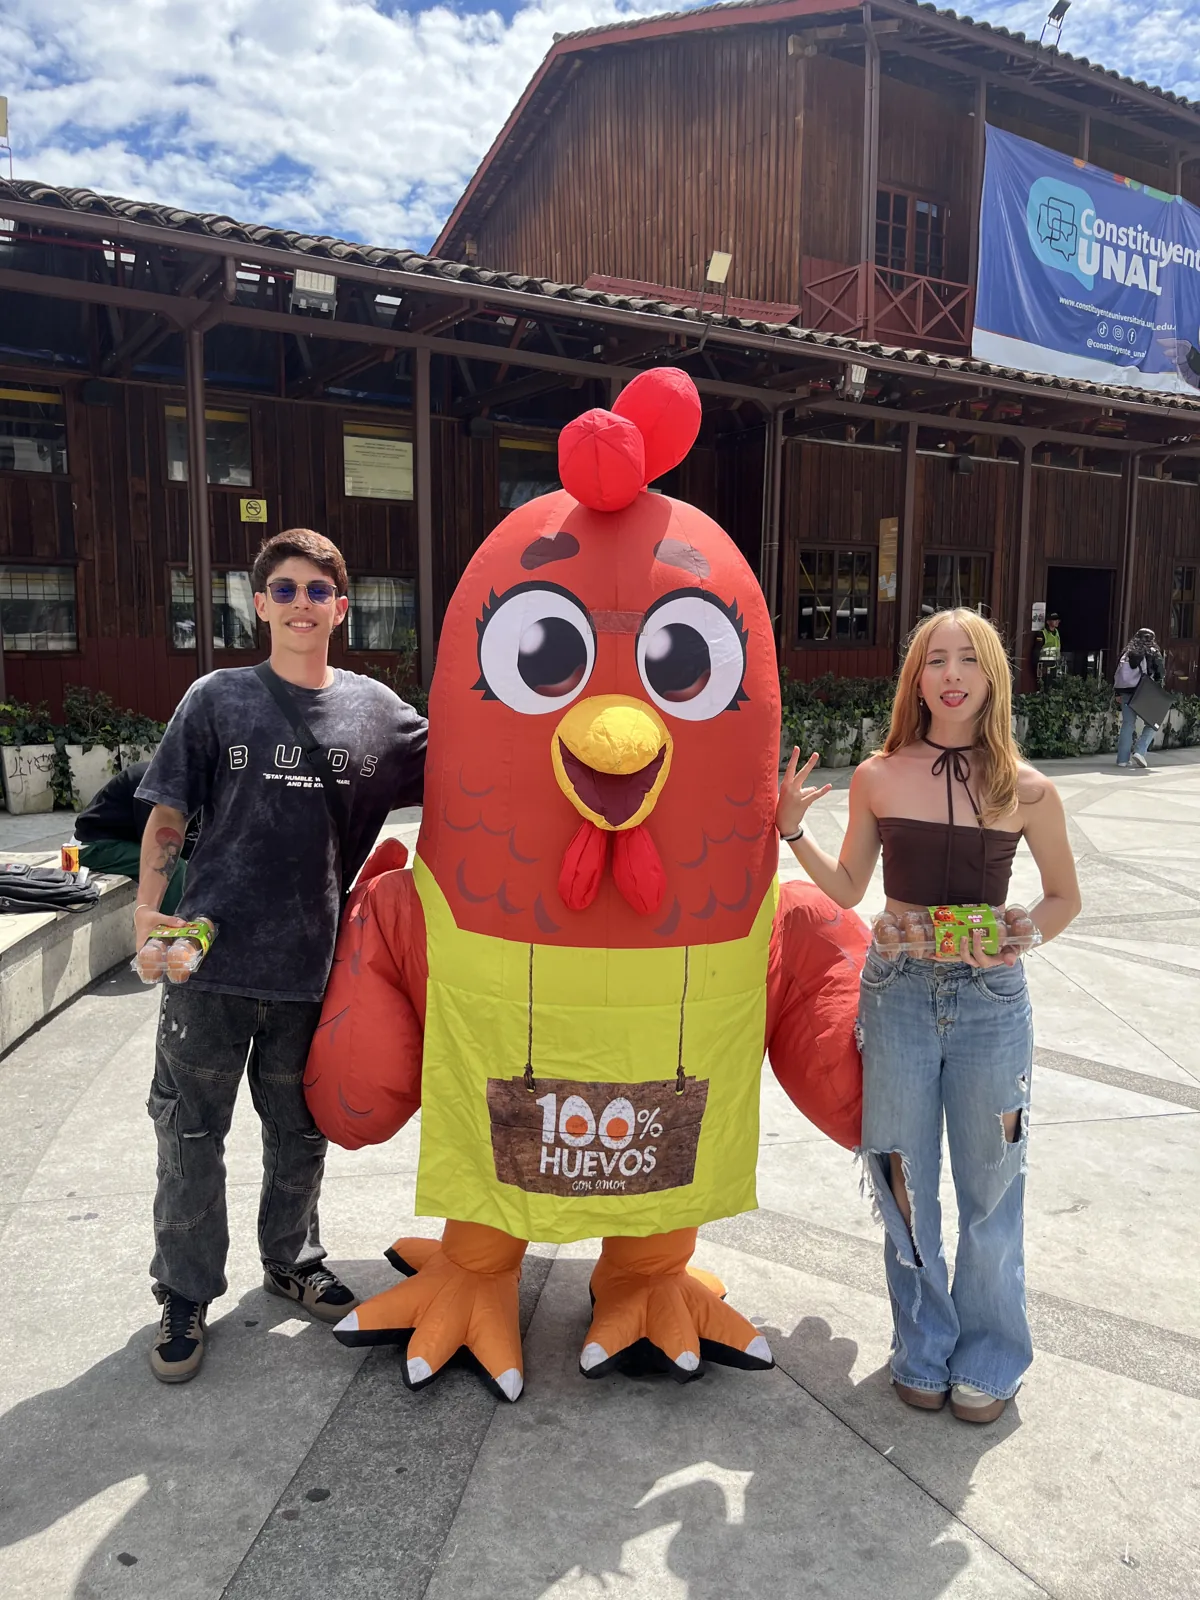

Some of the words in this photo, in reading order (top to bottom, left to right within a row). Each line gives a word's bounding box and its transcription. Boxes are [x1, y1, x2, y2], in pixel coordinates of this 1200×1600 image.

[1077, 237, 1163, 296] UNAL
[535, 1092, 664, 1150] 100%
[539, 1145, 658, 1178] HUEVOS
[571, 1180, 593, 1191] con
[595, 1179, 626, 1191] amor
